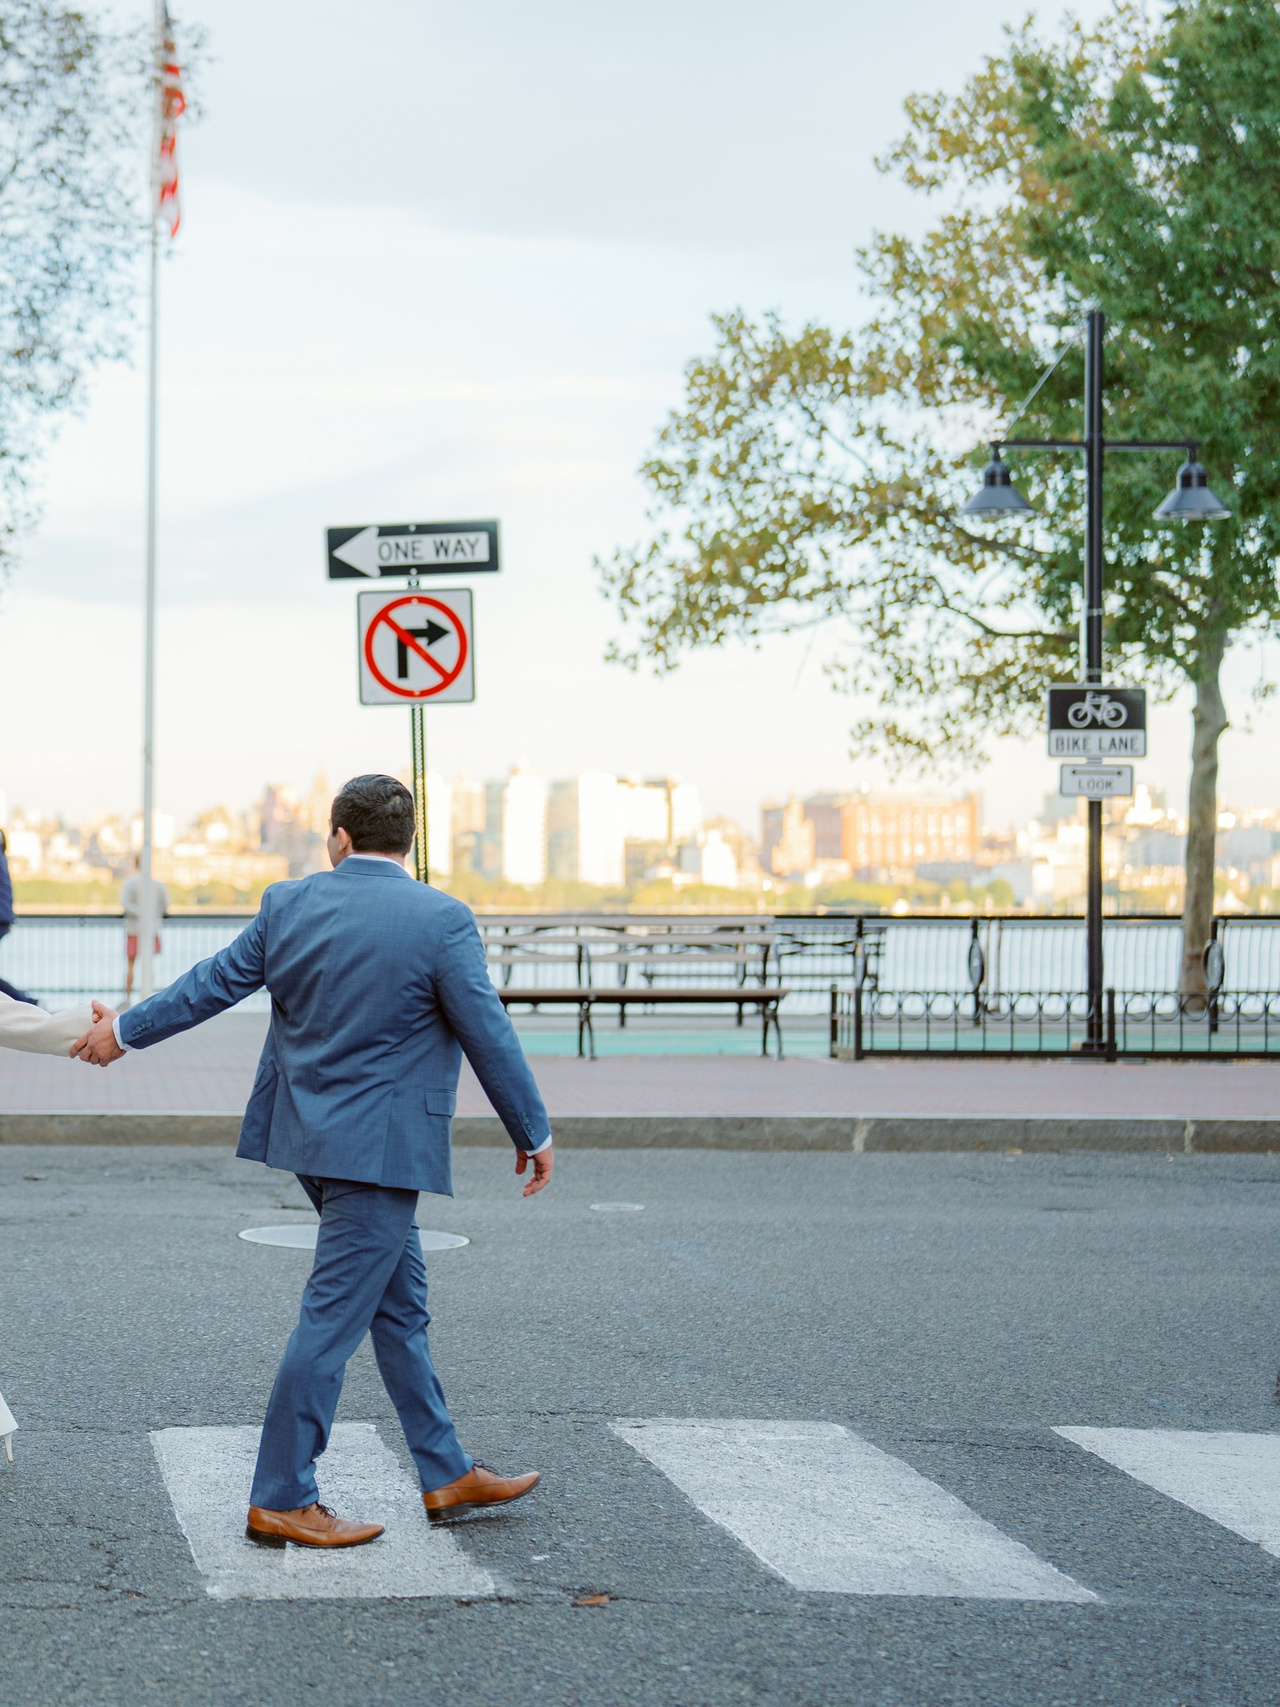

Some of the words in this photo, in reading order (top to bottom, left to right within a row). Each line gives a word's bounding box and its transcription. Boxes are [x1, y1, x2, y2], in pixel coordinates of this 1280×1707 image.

[378, 540, 424, 562] ONE
[433, 536, 480, 560] WAY
[1055, 736, 1091, 753] BIKE
[1098, 736, 1139, 753] LANE
[1078, 779, 1113, 791] LOOK
